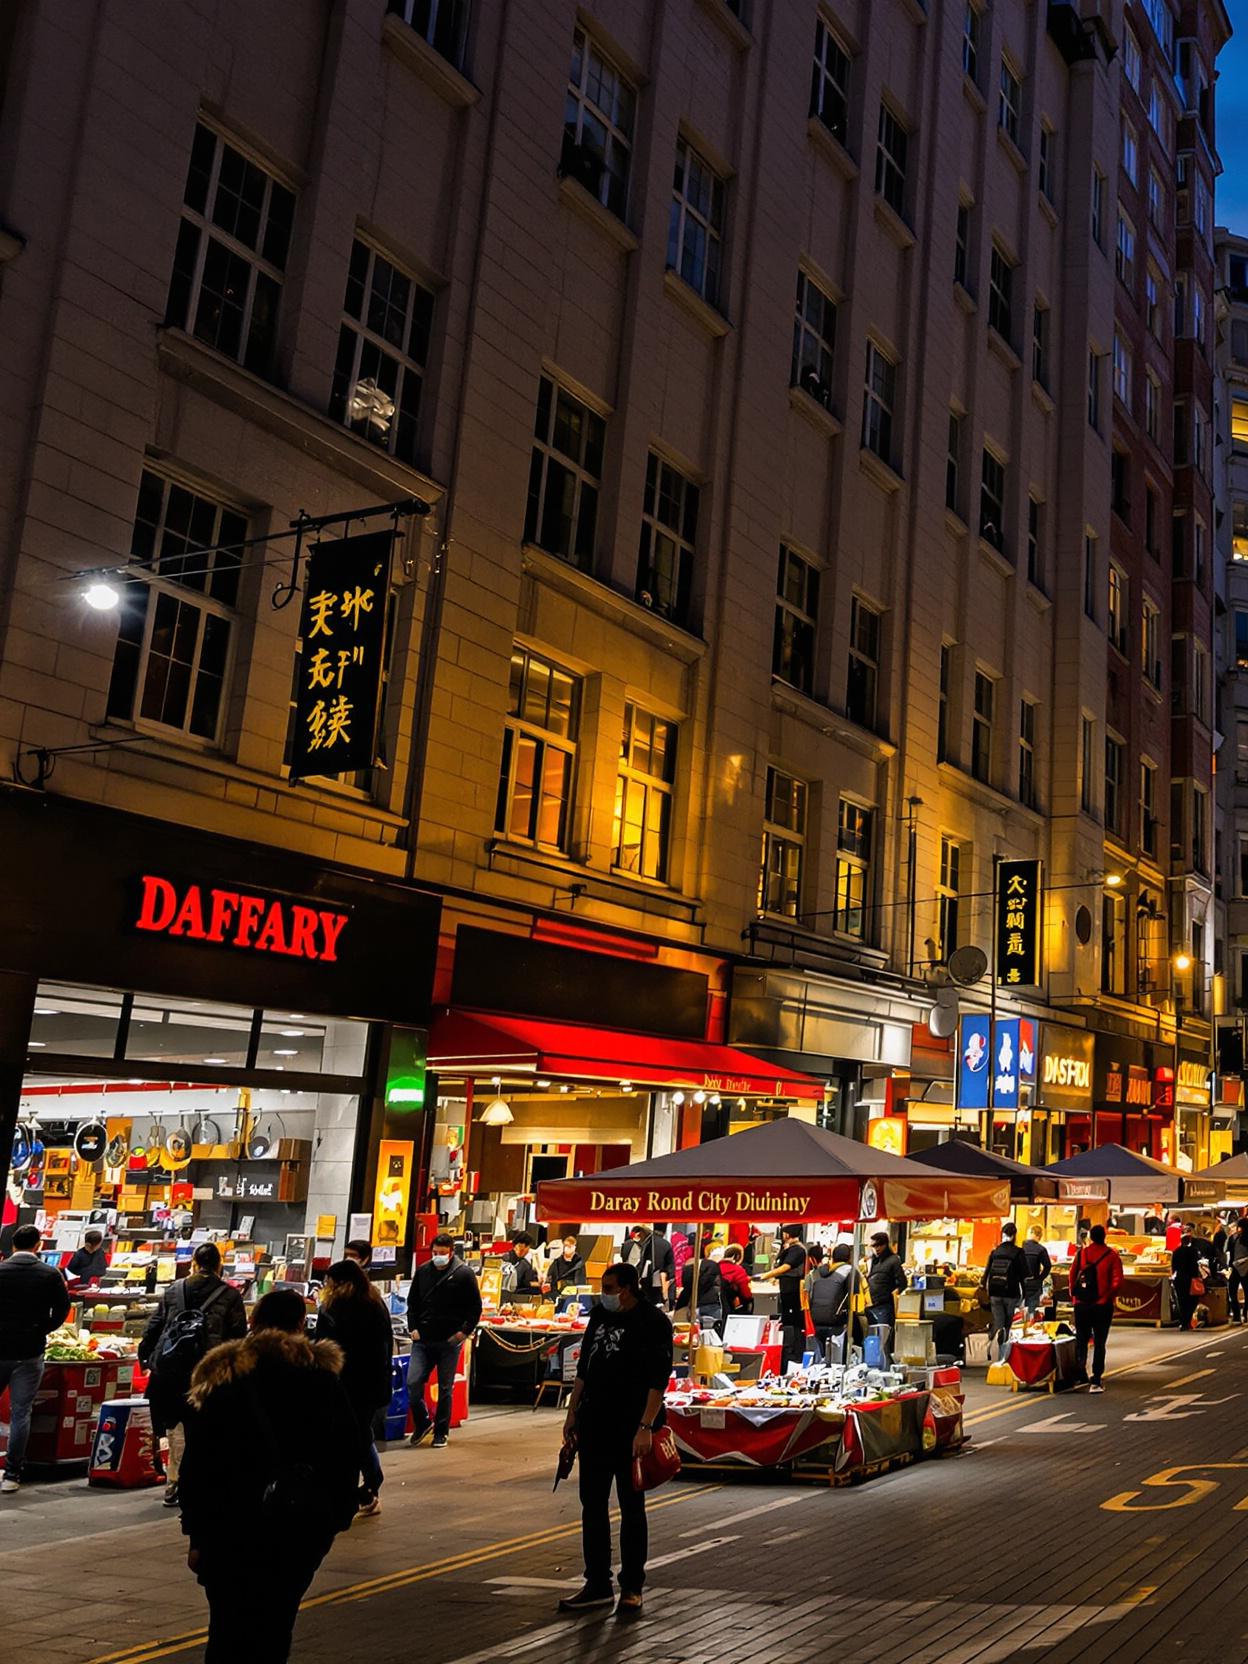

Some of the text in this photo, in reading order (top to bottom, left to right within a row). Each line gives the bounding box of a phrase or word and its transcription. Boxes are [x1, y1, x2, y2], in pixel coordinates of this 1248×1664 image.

[135, 875, 349, 962] DAFFARY
[590, 1191, 641, 1214] Daray
[647, 1190, 693, 1211] Rond
